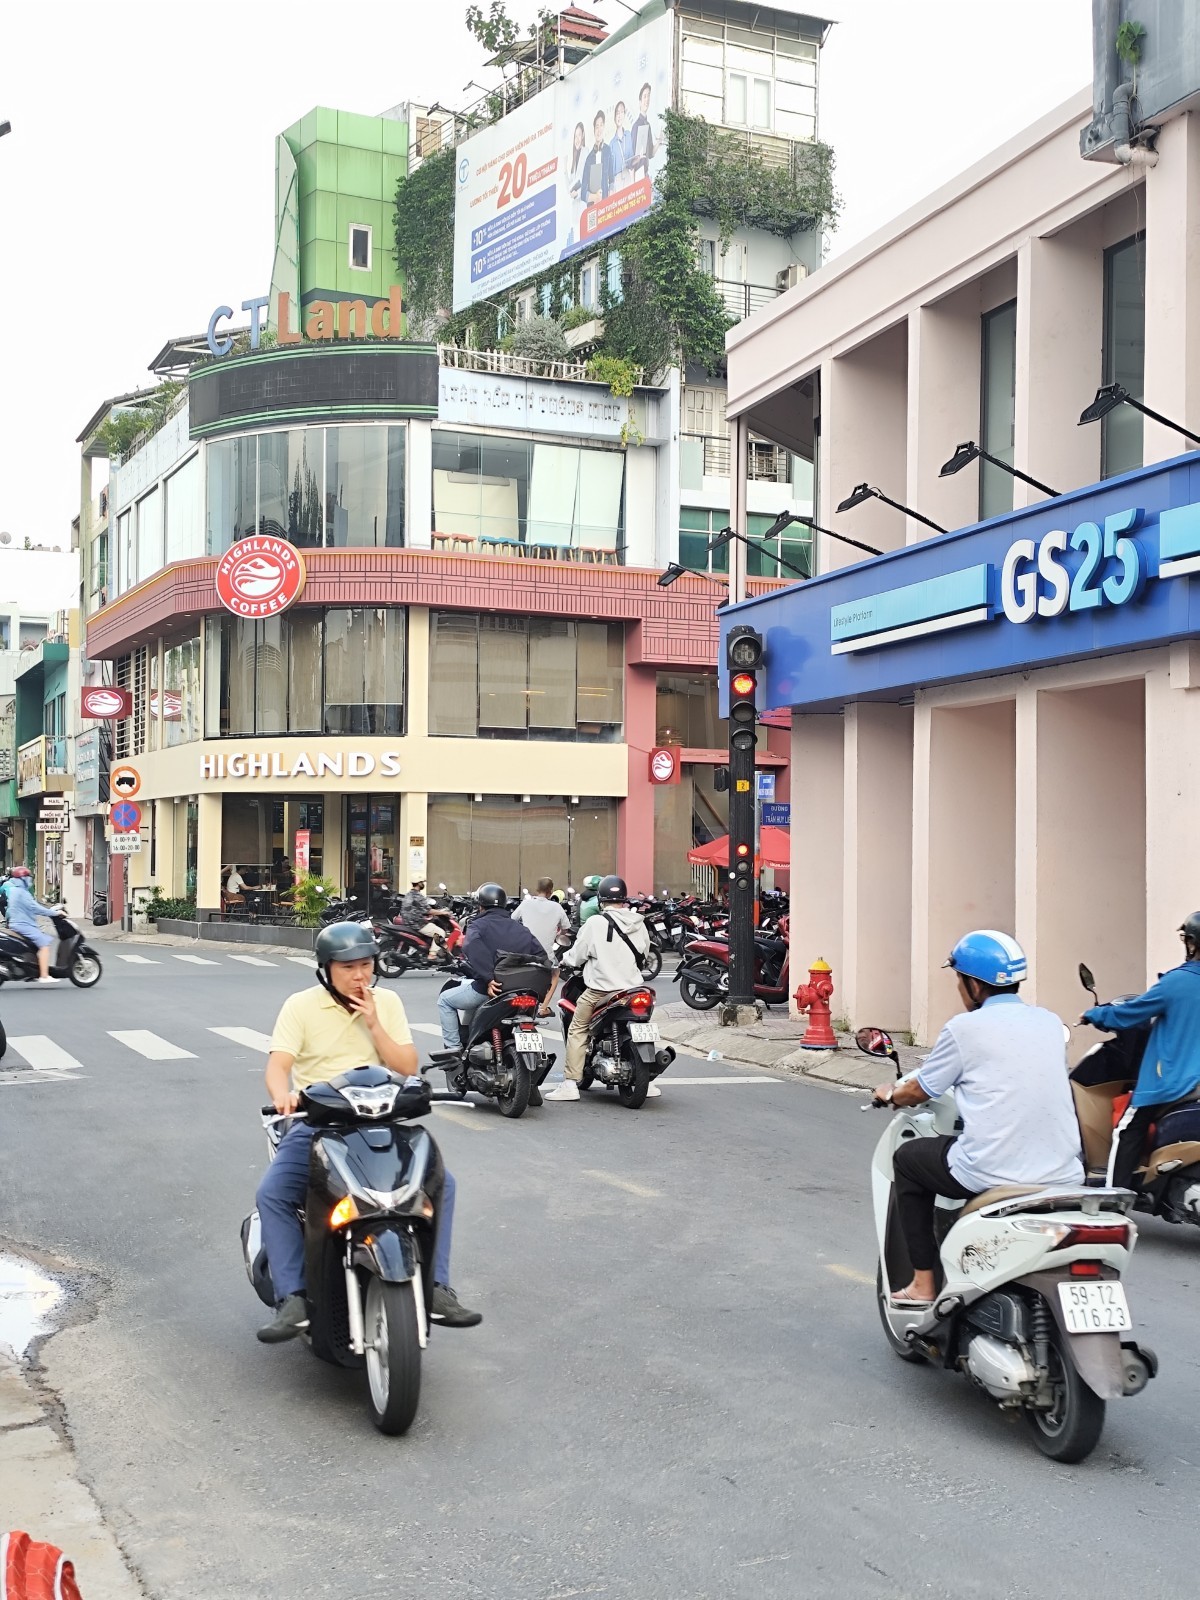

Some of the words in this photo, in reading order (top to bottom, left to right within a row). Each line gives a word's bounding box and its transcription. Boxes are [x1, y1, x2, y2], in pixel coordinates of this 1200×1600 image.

[497, 152, 528, 210] 20
[277, 285, 402, 344] Land
[221, 540, 296, 575] HIGHLANDS
[1001, 507, 1145, 625] GS25
[230, 592, 288, 614] COFFEE
[200, 751, 402, 778] HIGHLANDS
[1069, 1286, 1116, 1306] 59-T2
[1068, 1307, 1126, 1329] 116.23
